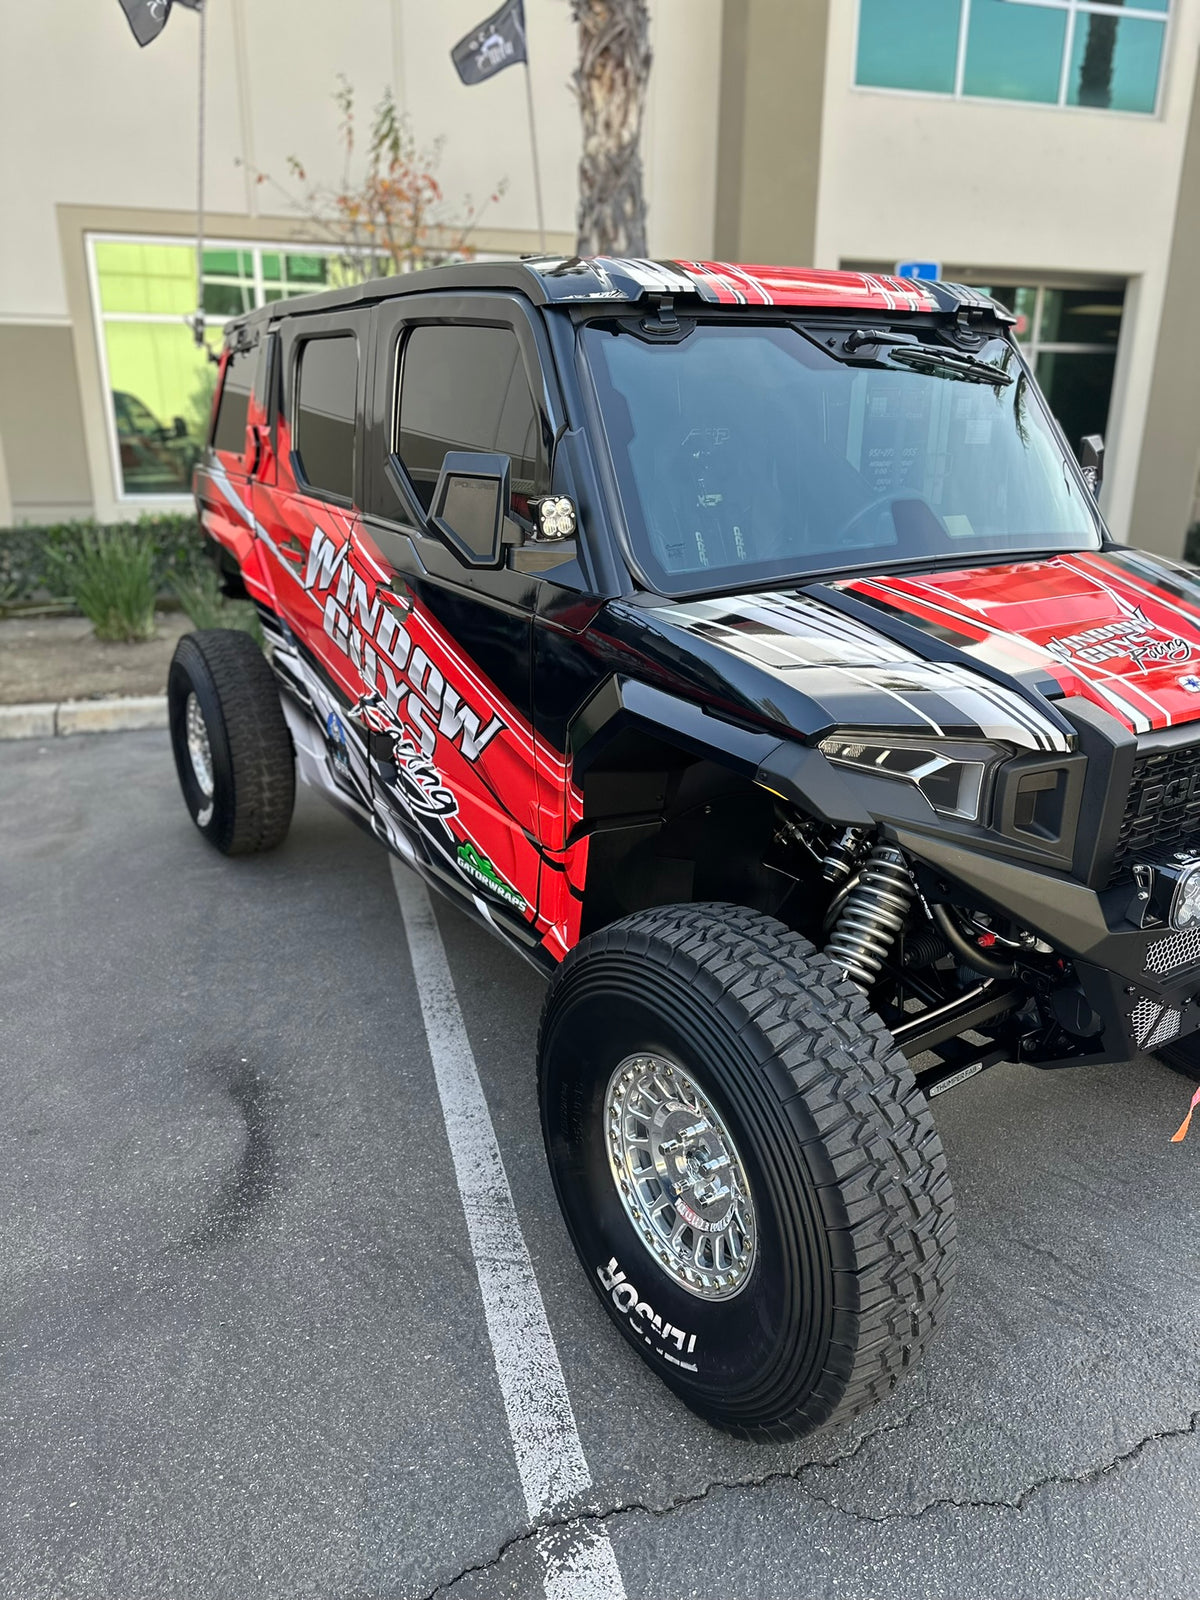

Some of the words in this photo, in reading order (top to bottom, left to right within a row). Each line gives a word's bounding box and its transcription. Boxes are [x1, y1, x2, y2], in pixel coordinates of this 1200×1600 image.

[304, 525, 504, 763] WINDOW
[1041, 604, 1157, 663] WINDOW
[1075, 632, 1158, 664] GUYS
[1120, 638, 1191, 675] Racing
[322, 594, 437, 758] GUYS
[457, 856, 527, 912] GATORWRAPS
